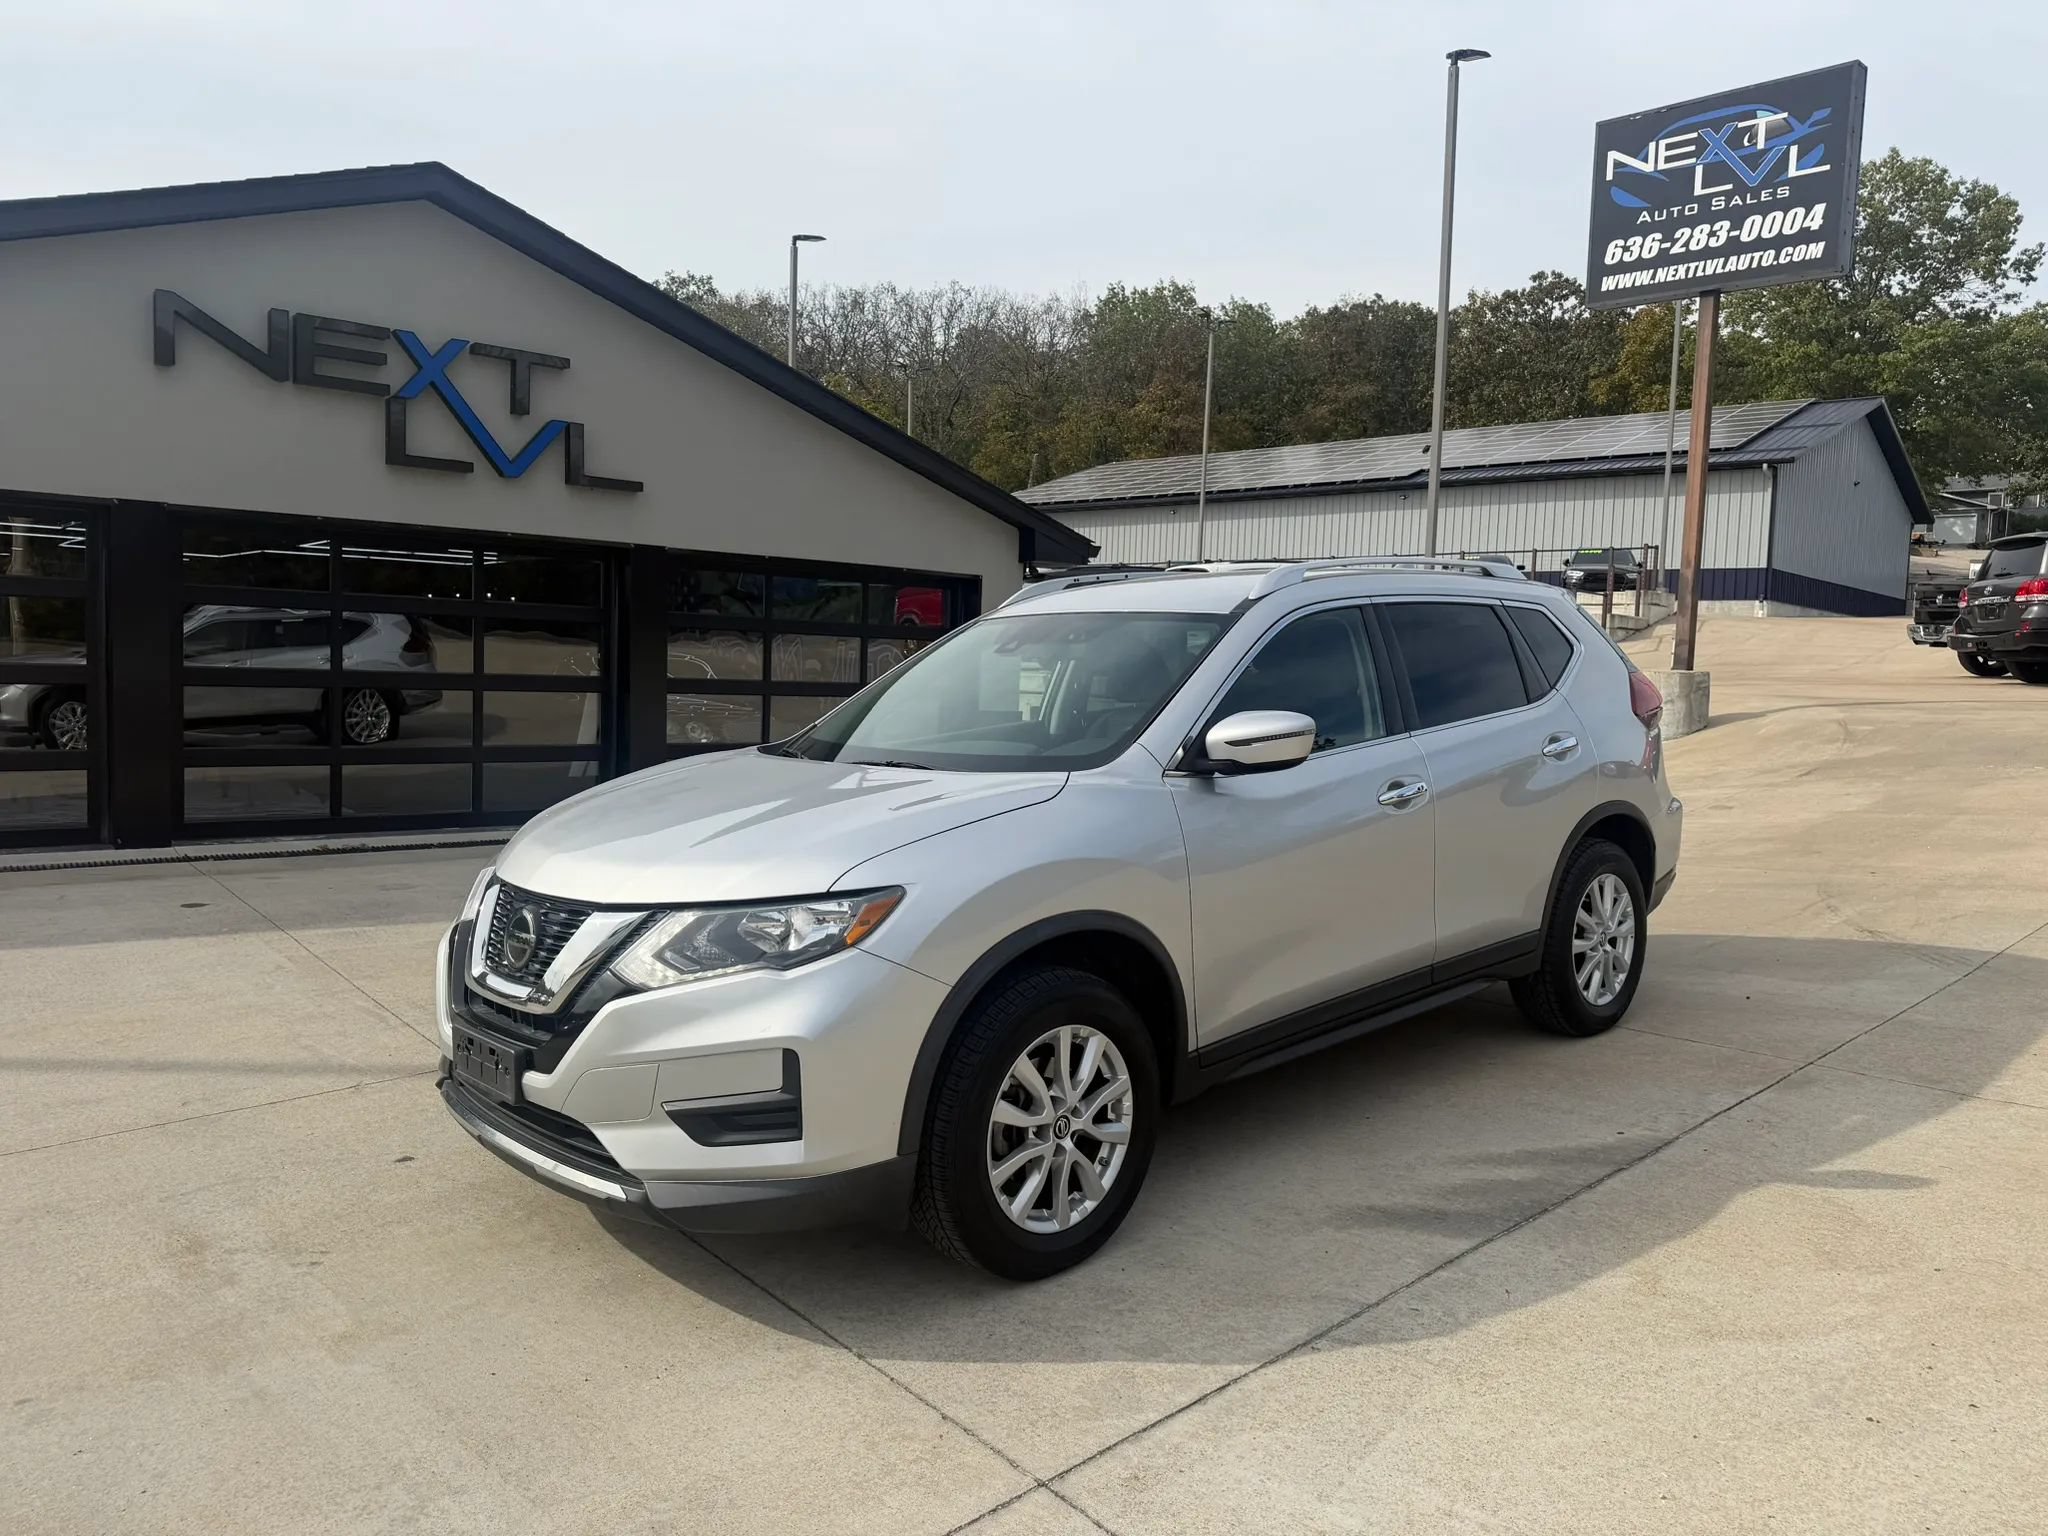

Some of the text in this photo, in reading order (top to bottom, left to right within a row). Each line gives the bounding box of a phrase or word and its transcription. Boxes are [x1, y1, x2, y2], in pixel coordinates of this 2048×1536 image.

[1606, 112, 1789, 181] NEXT
[1694, 145, 1831, 196] LVL
[1604, 203, 1826, 265] 636-283-0004
[1637, 187, 1790, 224] AUTO SALES
[1602, 242, 1825, 291] WWW.NEXTLVLAUTO.COM
[154, 289, 570, 415] NEXT
[386, 396, 643, 492] LVL
